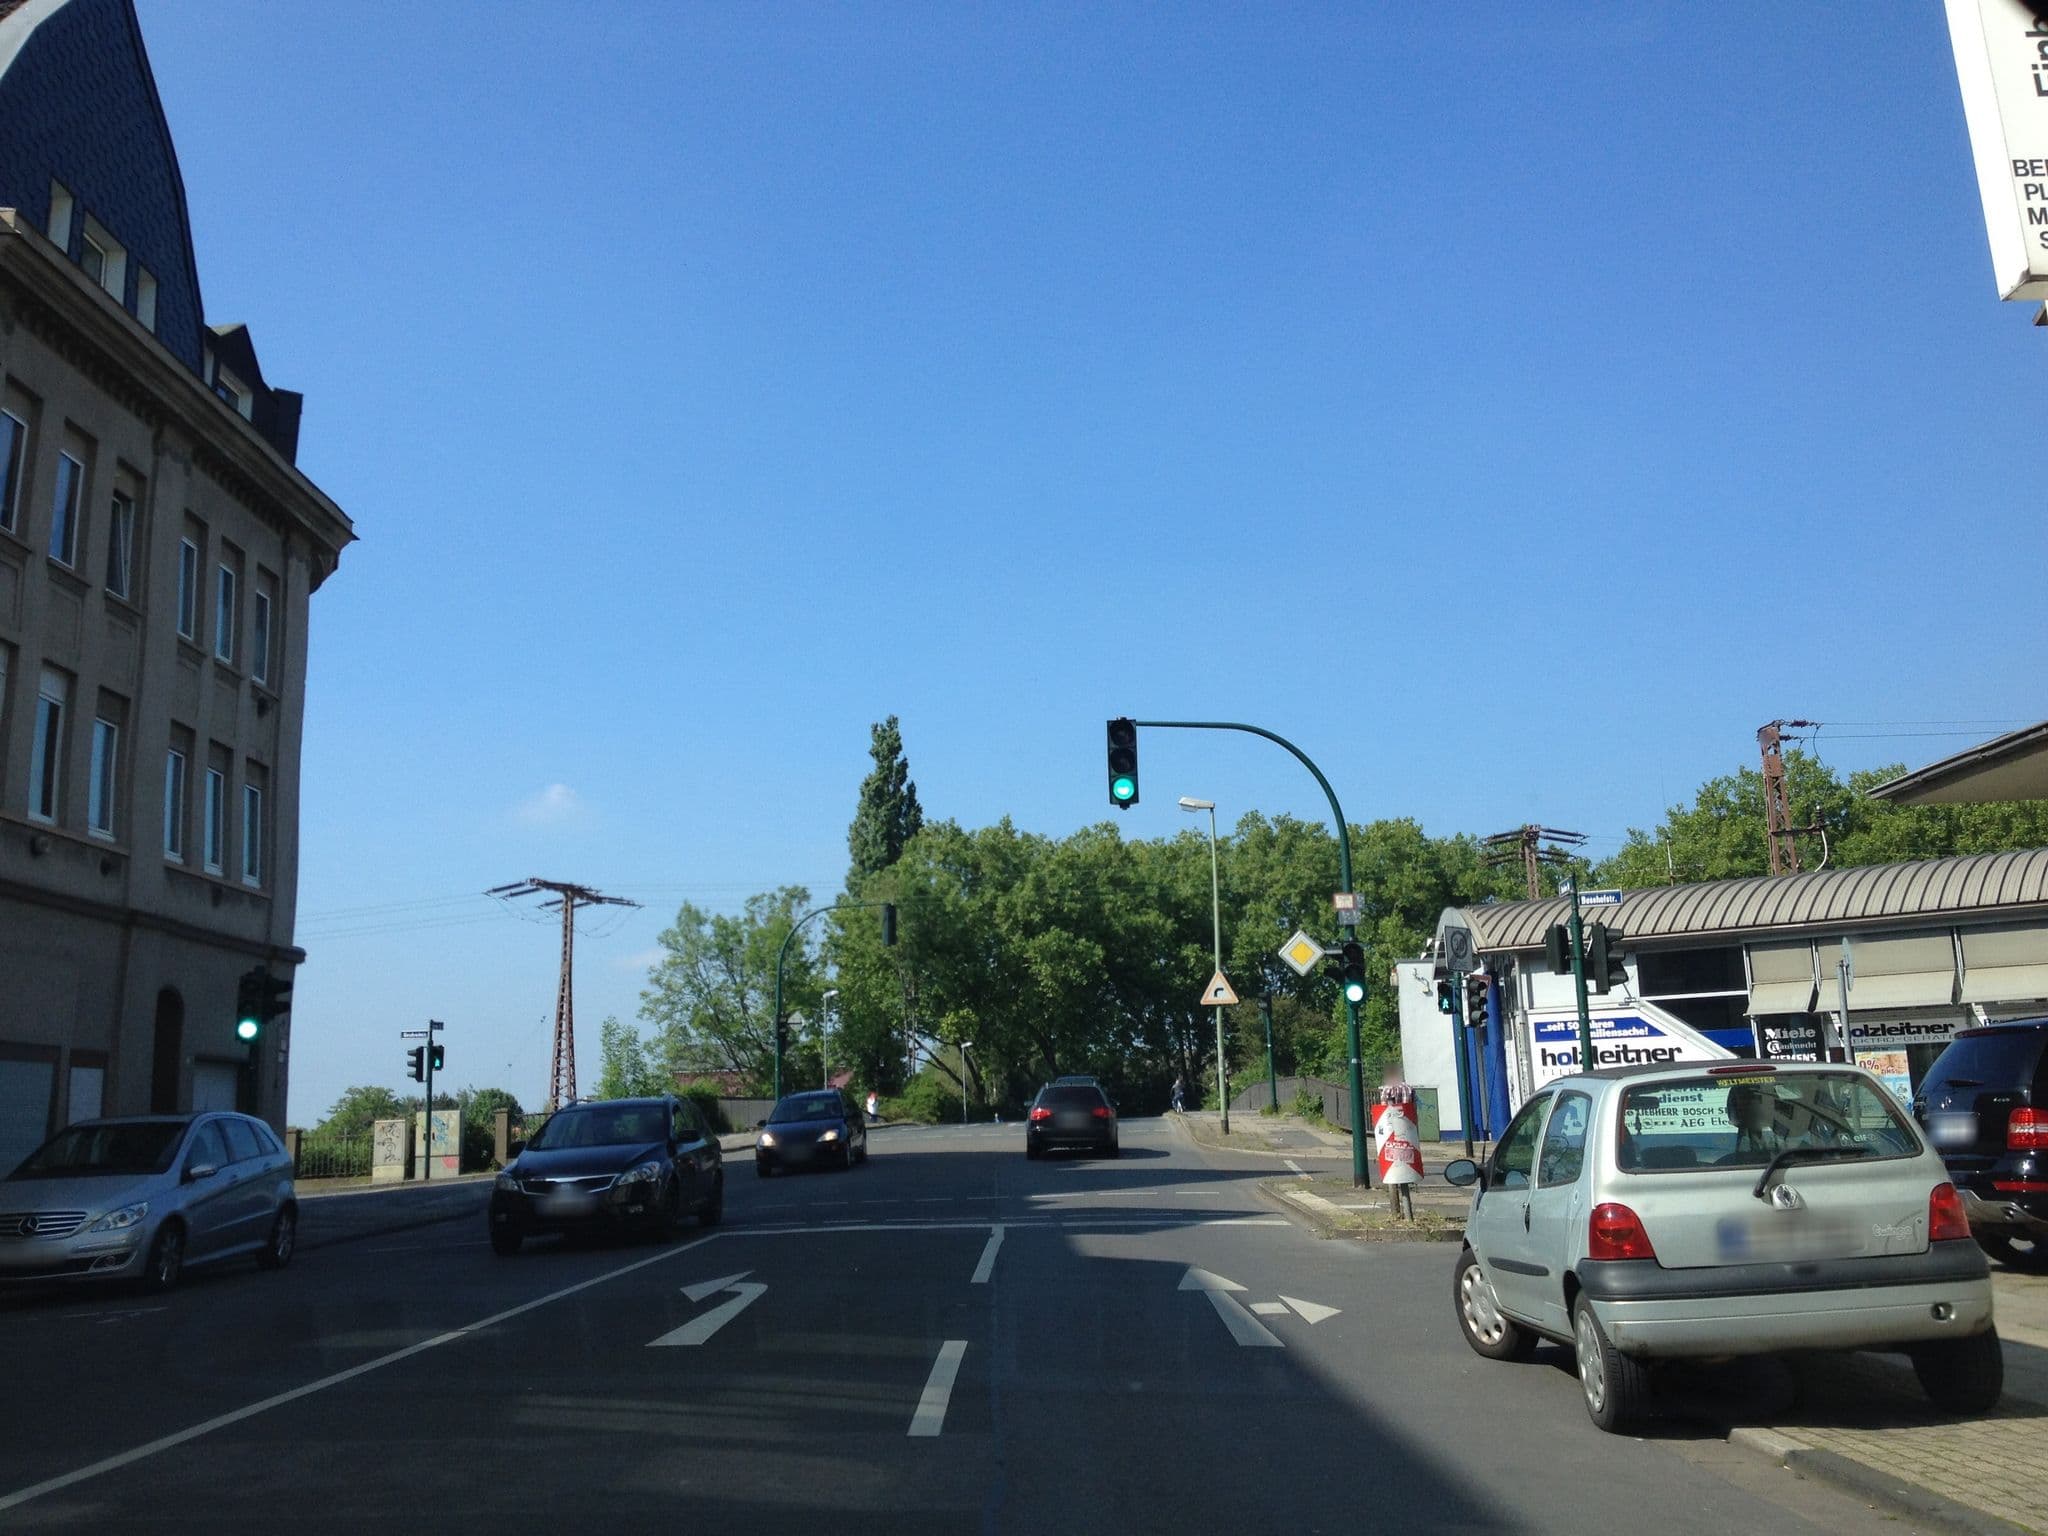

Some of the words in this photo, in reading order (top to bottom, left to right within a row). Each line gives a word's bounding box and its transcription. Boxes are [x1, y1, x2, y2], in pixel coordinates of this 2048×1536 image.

[1764, 1026, 1816, 1040] Miele
[1682, 1107, 1714, 1116] BOSCH
[1681, 1118, 1705, 1128] AEG
